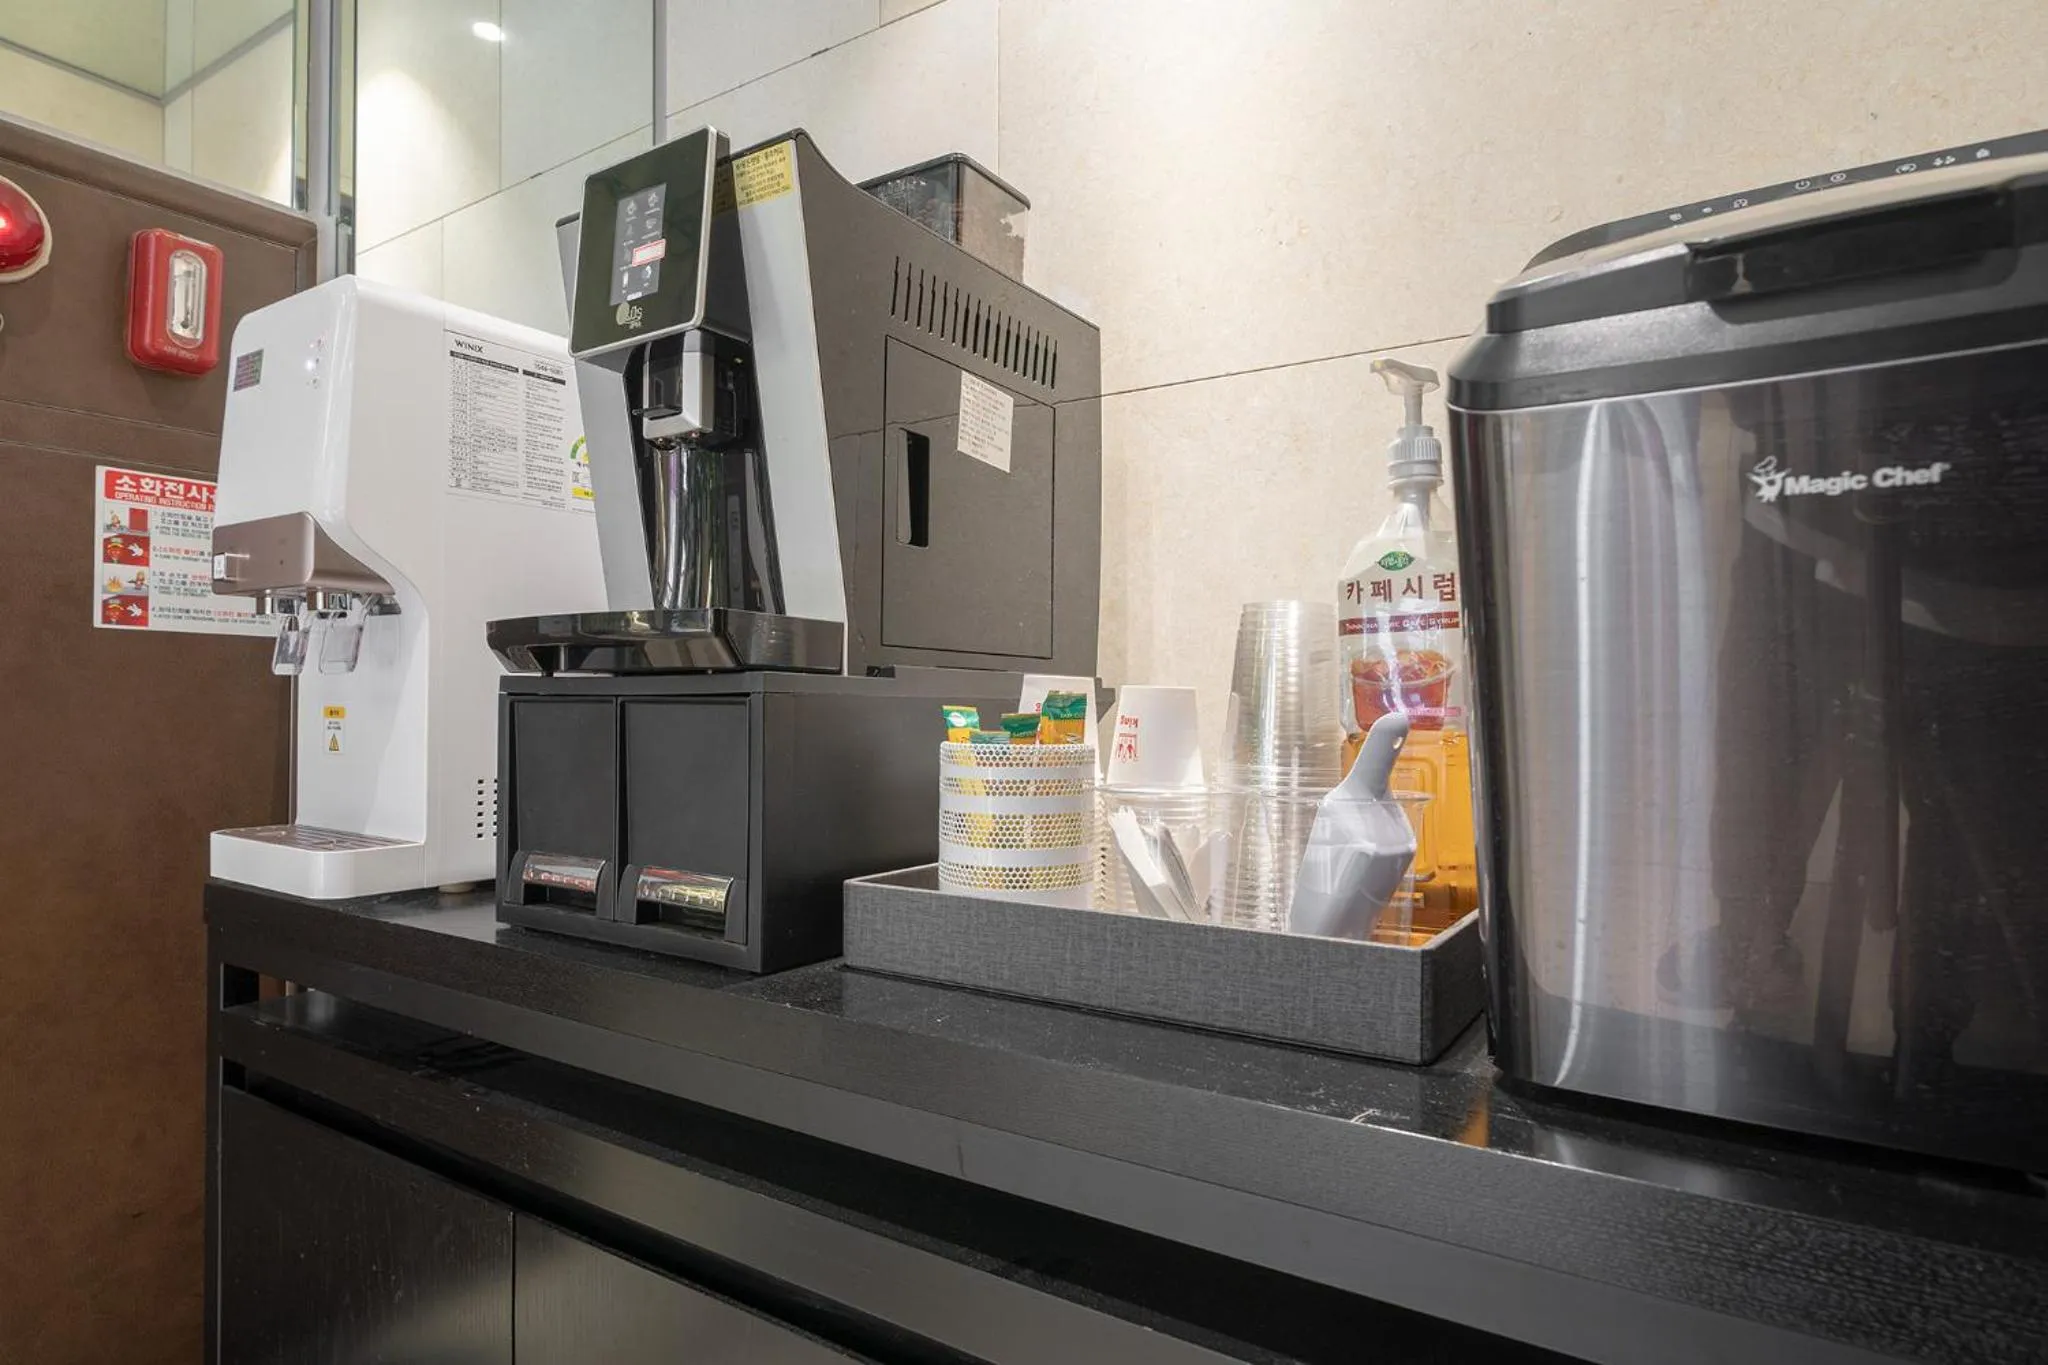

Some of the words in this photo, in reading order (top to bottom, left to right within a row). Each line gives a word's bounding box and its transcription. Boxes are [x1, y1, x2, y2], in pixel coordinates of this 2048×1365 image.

[455, 339, 484, 353] WINIX
[1783, 471, 1868, 496] Magic
[1872, 461, 1944, 488] Chef
[114, 491, 157, 504] OPERATING
[159, 497, 207, 510] INSTRUCTION
[1346, 572, 1457, 605] 카페시럽
